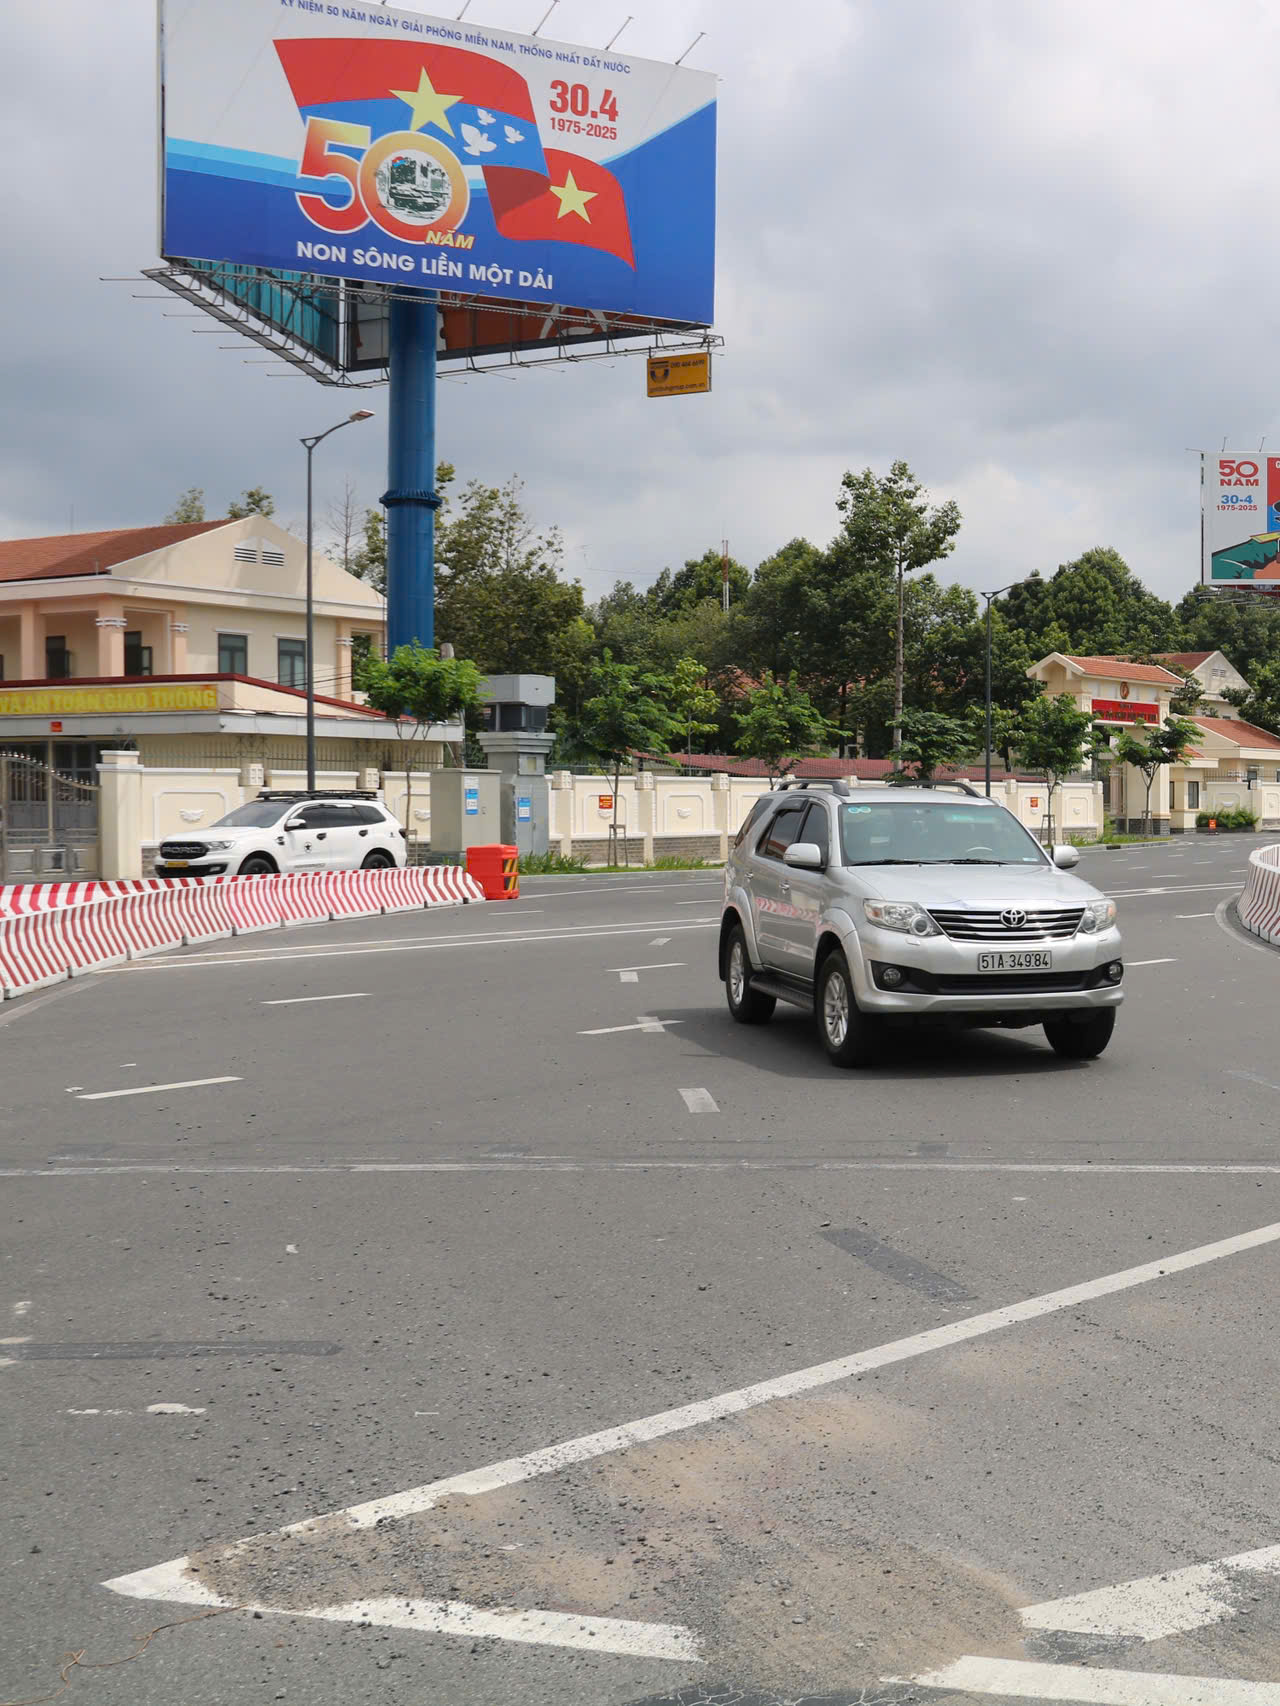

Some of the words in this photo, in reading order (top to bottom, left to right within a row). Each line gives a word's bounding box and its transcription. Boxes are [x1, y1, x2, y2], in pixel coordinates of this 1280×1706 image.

[327, 5, 339, 17] 50
[342, 8, 367, 22] NĂM
[369, 14, 399, 28] NGÀY
[402, 19, 424, 33] GIẢI
[426, 25, 462, 41] PHÓNG
[465, 32, 488, 47] MIỀN
[491, 39, 517, 54] NAM,
[519, 43, 553, 59] THỐNG
[556, 50, 580, 65] NHẤT
[583, 55, 601, 69] ĐẤT
[603, 61, 631, 74] NƯỚC
[549, 79, 619, 122] 30.4
[550, 117, 617, 140] 1975-2025
[295, 115, 470, 243] 50
[424, 228, 475, 250] NĂM
[297, 241, 346, 264] NON
[352, 247, 416, 272] SÔNG
[421, 251, 463, 278] LIỀN
[469, 263, 514, 288] MỘT
[519, 268, 553, 290] DẢI
[1218, 459, 1260, 478] 50
[1219, 477, 1260, 487] NĂM
[1221, 494, 1253, 504] 30-4
[103, 692, 148, 710] GIAO
[152, 687, 216, 709] THÔNG
